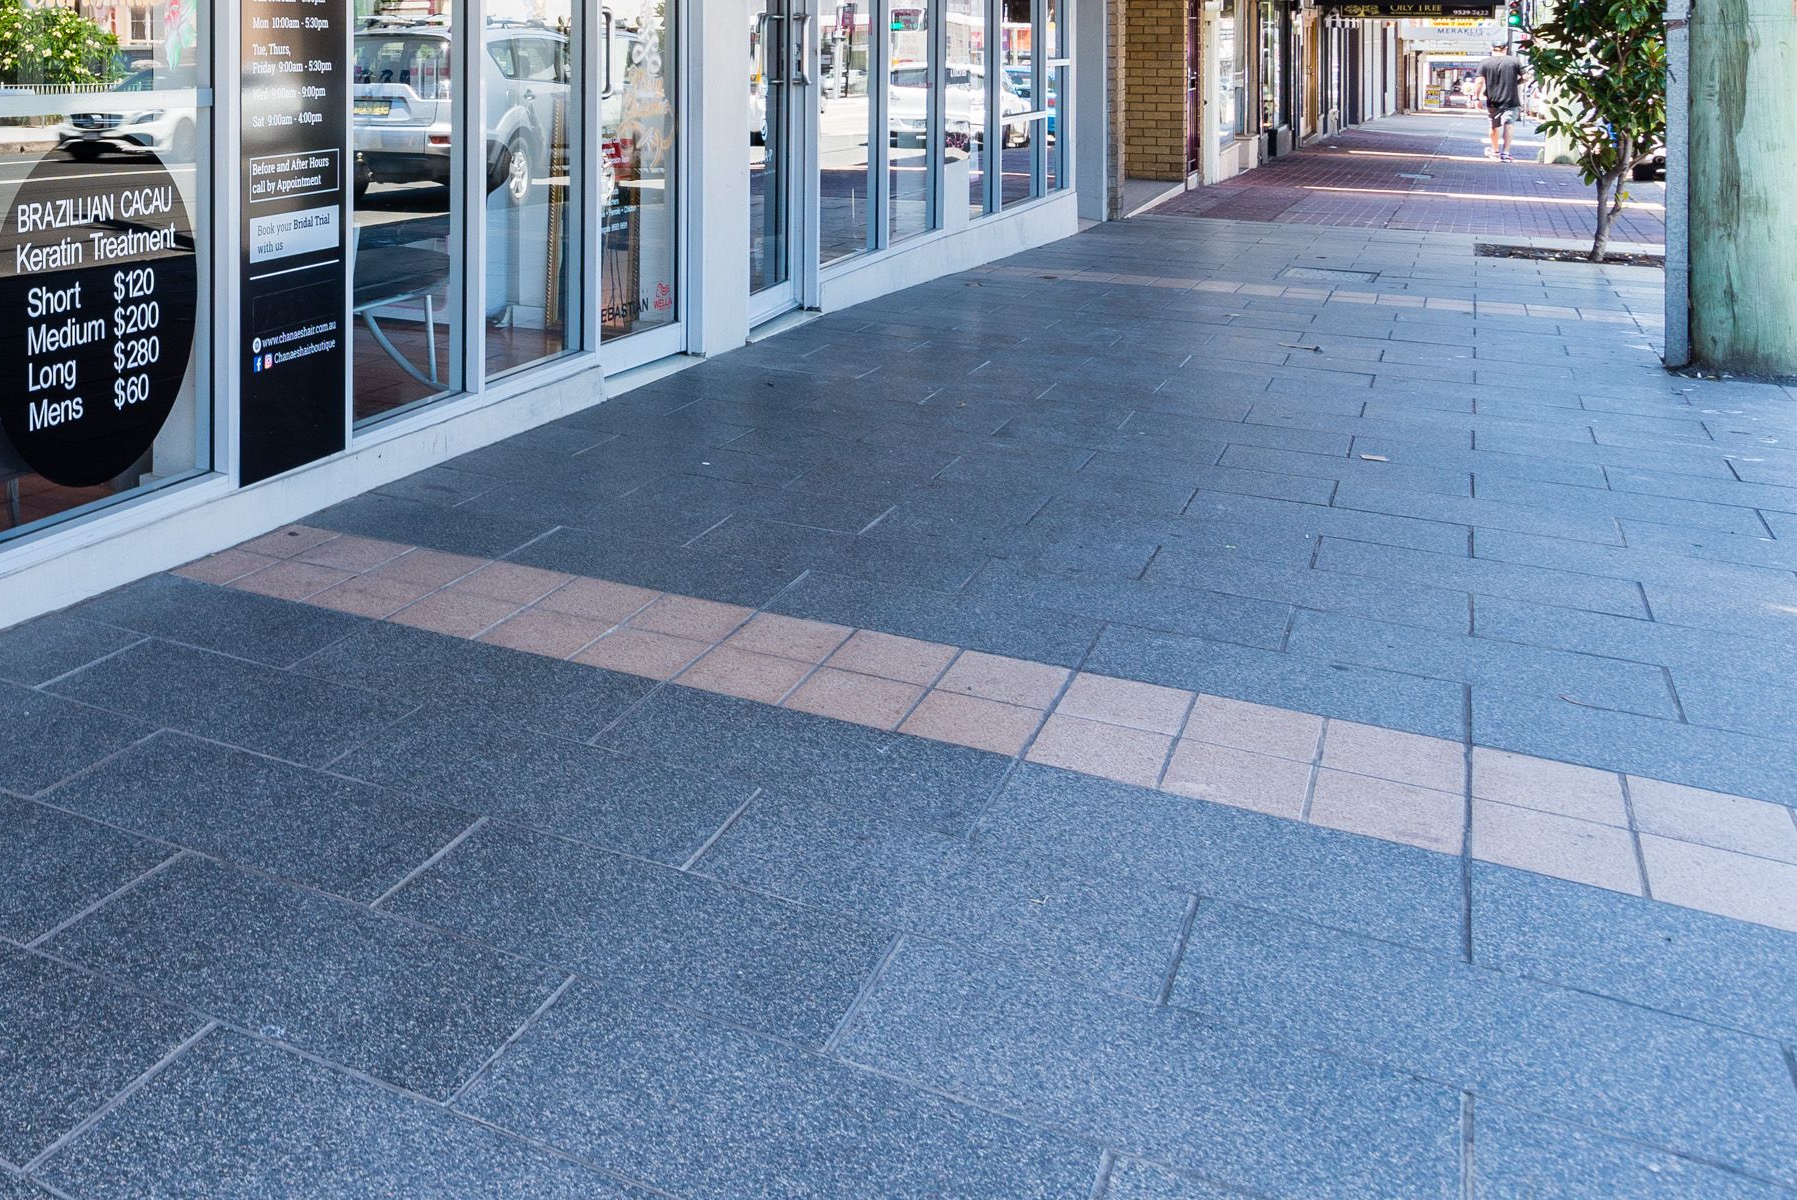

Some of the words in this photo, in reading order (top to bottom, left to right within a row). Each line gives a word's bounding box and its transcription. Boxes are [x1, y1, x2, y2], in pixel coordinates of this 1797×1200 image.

[252, 16, 269, 29] Mon
[272, 16, 300, 29] 10:00am
[305, 17, 329, 31] 5:30pm
[252, 43, 268, 57] Tue,
[268, 42, 292, 57] Thurs,
[252, 61, 276, 76] Friday
[278, 60, 304, 73] 9:00am
[308, 60, 333, 74] 5:30pm
[301, 85, 326, 100] 9:00pm
[252, 115, 265, 128] Sat
[267, 114, 293, 127] 9:00am
[298, 112, 323, 126] 4:00pm
[252, 161, 276, 176] Before
[276, 159, 290, 173] and
[291, 158, 309, 171] After
[309, 156, 330, 169] Hours
[252, 180, 266, 194] call
[266, 179, 276, 194] by
[276, 174, 322, 193] Appointment
[16, 192, 115, 234] BRAZILLIAN
[119, 185, 173, 220] CACAU
[257, 222, 276, 237] Book
[276, 221, 292, 236] your
[293, 216, 314, 230] Bridal
[314, 213, 330, 227] Trial
[16, 236, 83, 275] Keratin
[89, 221, 177, 263] Treatment
[257, 241, 274, 255] with
[275, 241, 284, 251] us
[27, 280, 82, 319] Short
[113, 266, 155, 304] $120
[602, 297, 649, 324] EBASTIAN
[653, 296, 673, 311] WELLA
[27, 315, 106, 357] Medium
[113, 300, 160, 340] $200
[262, 320, 337, 348] www.chanaeshair.com.au
[274, 339, 336, 364] Chanaeshairboutique
[27, 358, 78, 393] Long
[113, 335, 160, 375] $280
[28, 395, 84, 433] Mens
[113, 372, 150, 411] $60
